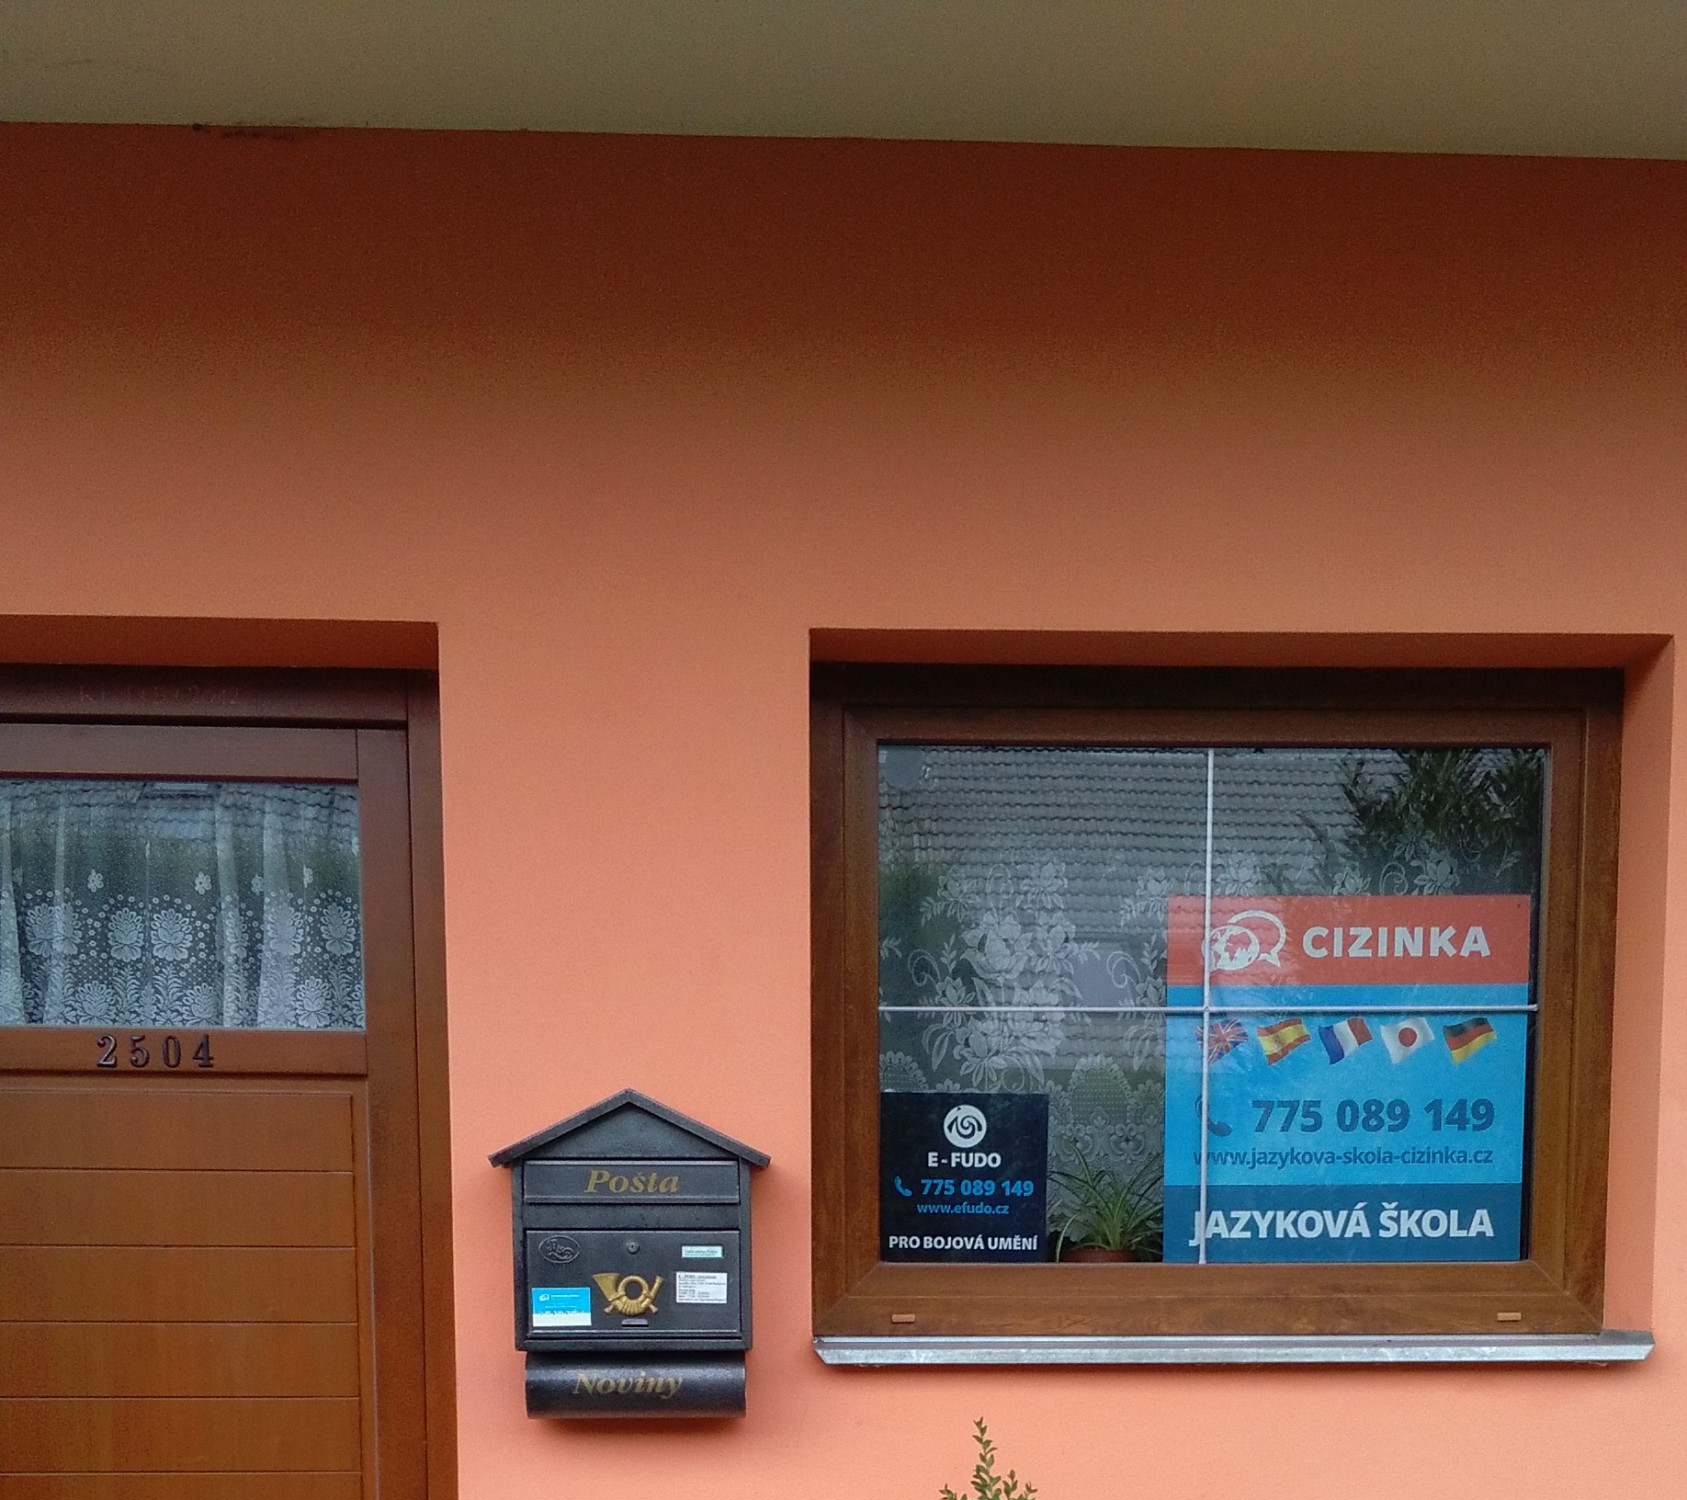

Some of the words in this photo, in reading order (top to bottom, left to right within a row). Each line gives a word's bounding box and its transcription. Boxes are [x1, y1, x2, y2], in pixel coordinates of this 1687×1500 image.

[1302, 925, 1492, 958] CIZINKA
[96, 1033, 214, 1068] 2504
[1251, 1099, 1323, 1133] 775
[1335, 1098, 1411, 1133] 089
[1424, 1097, 1495, 1132] 149
[1193, 1146, 1494, 1170] www.jazykova-skola-cizinka.cz
[584, 1169, 680, 1194] Pošta
[920, 1178, 956, 1196] 775
[960, 1178, 996, 1197] 089
[1001, 1179, 1035, 1198] 149
[916, 1201, 1010, 1215] www.efudo.cz
[1188, 1202, 1372, 1247] JAZYKOVÁ
[1378, 1201, 1495, 1239] ŠKOLA
[888, 1235, 921, 1250] PRO
[923, 1233, 985, 1251] BOJOVÁ
[987, 1234, 1039, 1251] UMĚNÍ
[572, 1370, 684, 1399] Noviny
